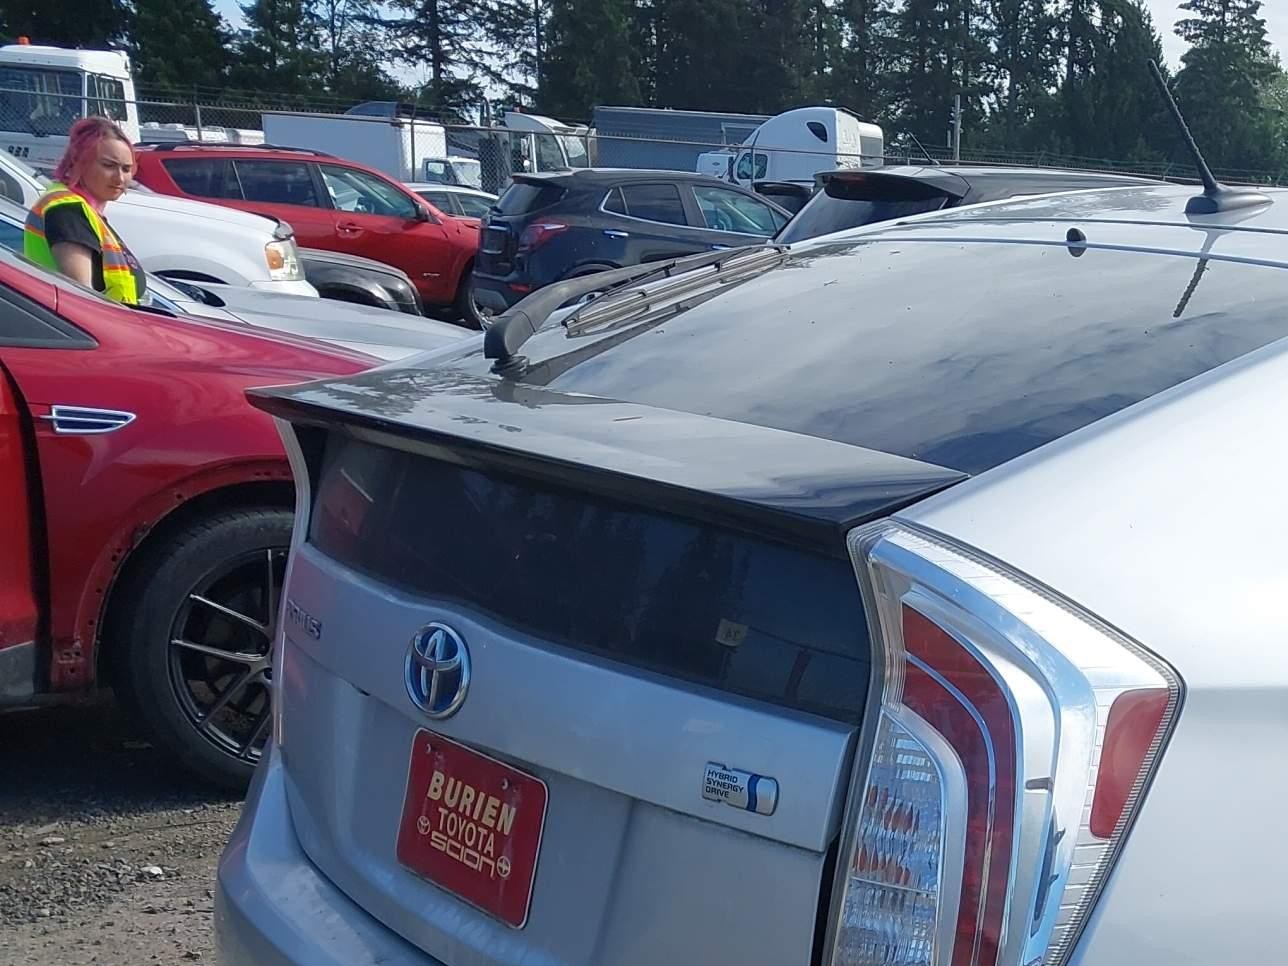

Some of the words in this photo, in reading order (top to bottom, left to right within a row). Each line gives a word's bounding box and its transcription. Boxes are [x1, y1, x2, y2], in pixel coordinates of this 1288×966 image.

[707, 769, 738, 784] HYBRID
[705, 785, 730, 799] DRIVE
[706, 777, 745, 793] SYNERGY
[427, 770, 517, 836] BURIEN
[438, 807, 496, 858] TOYOTA
